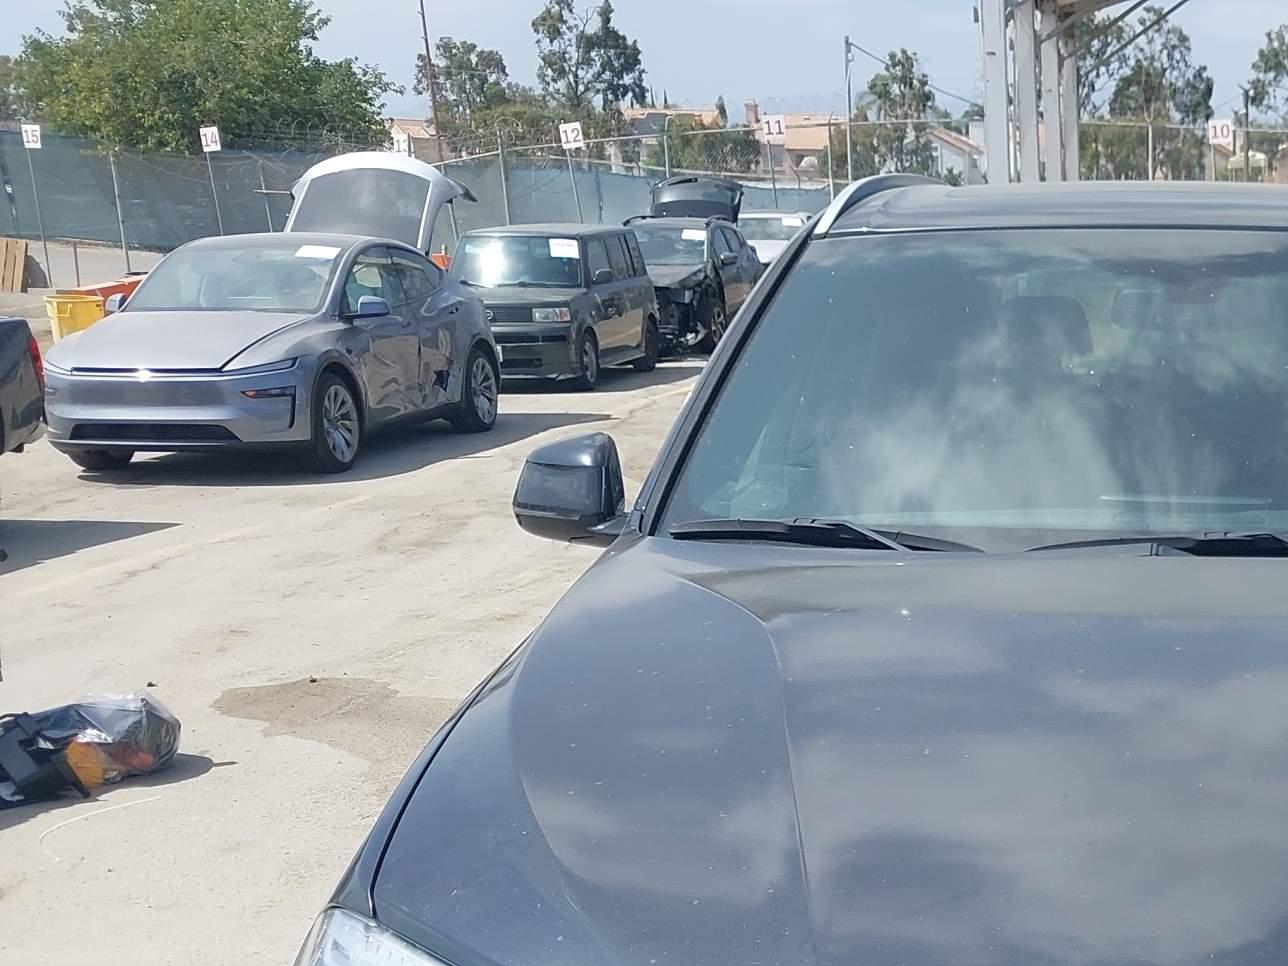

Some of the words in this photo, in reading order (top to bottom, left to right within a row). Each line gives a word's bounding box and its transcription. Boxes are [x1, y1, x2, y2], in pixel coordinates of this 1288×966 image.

[561, 127, 582, 144] 12
[764, 119, 785, 136] 11
[1211, 123, 1231, 139] 10
[23, 129, 39, 144] 15
[201, 131, 218, 147] 14
